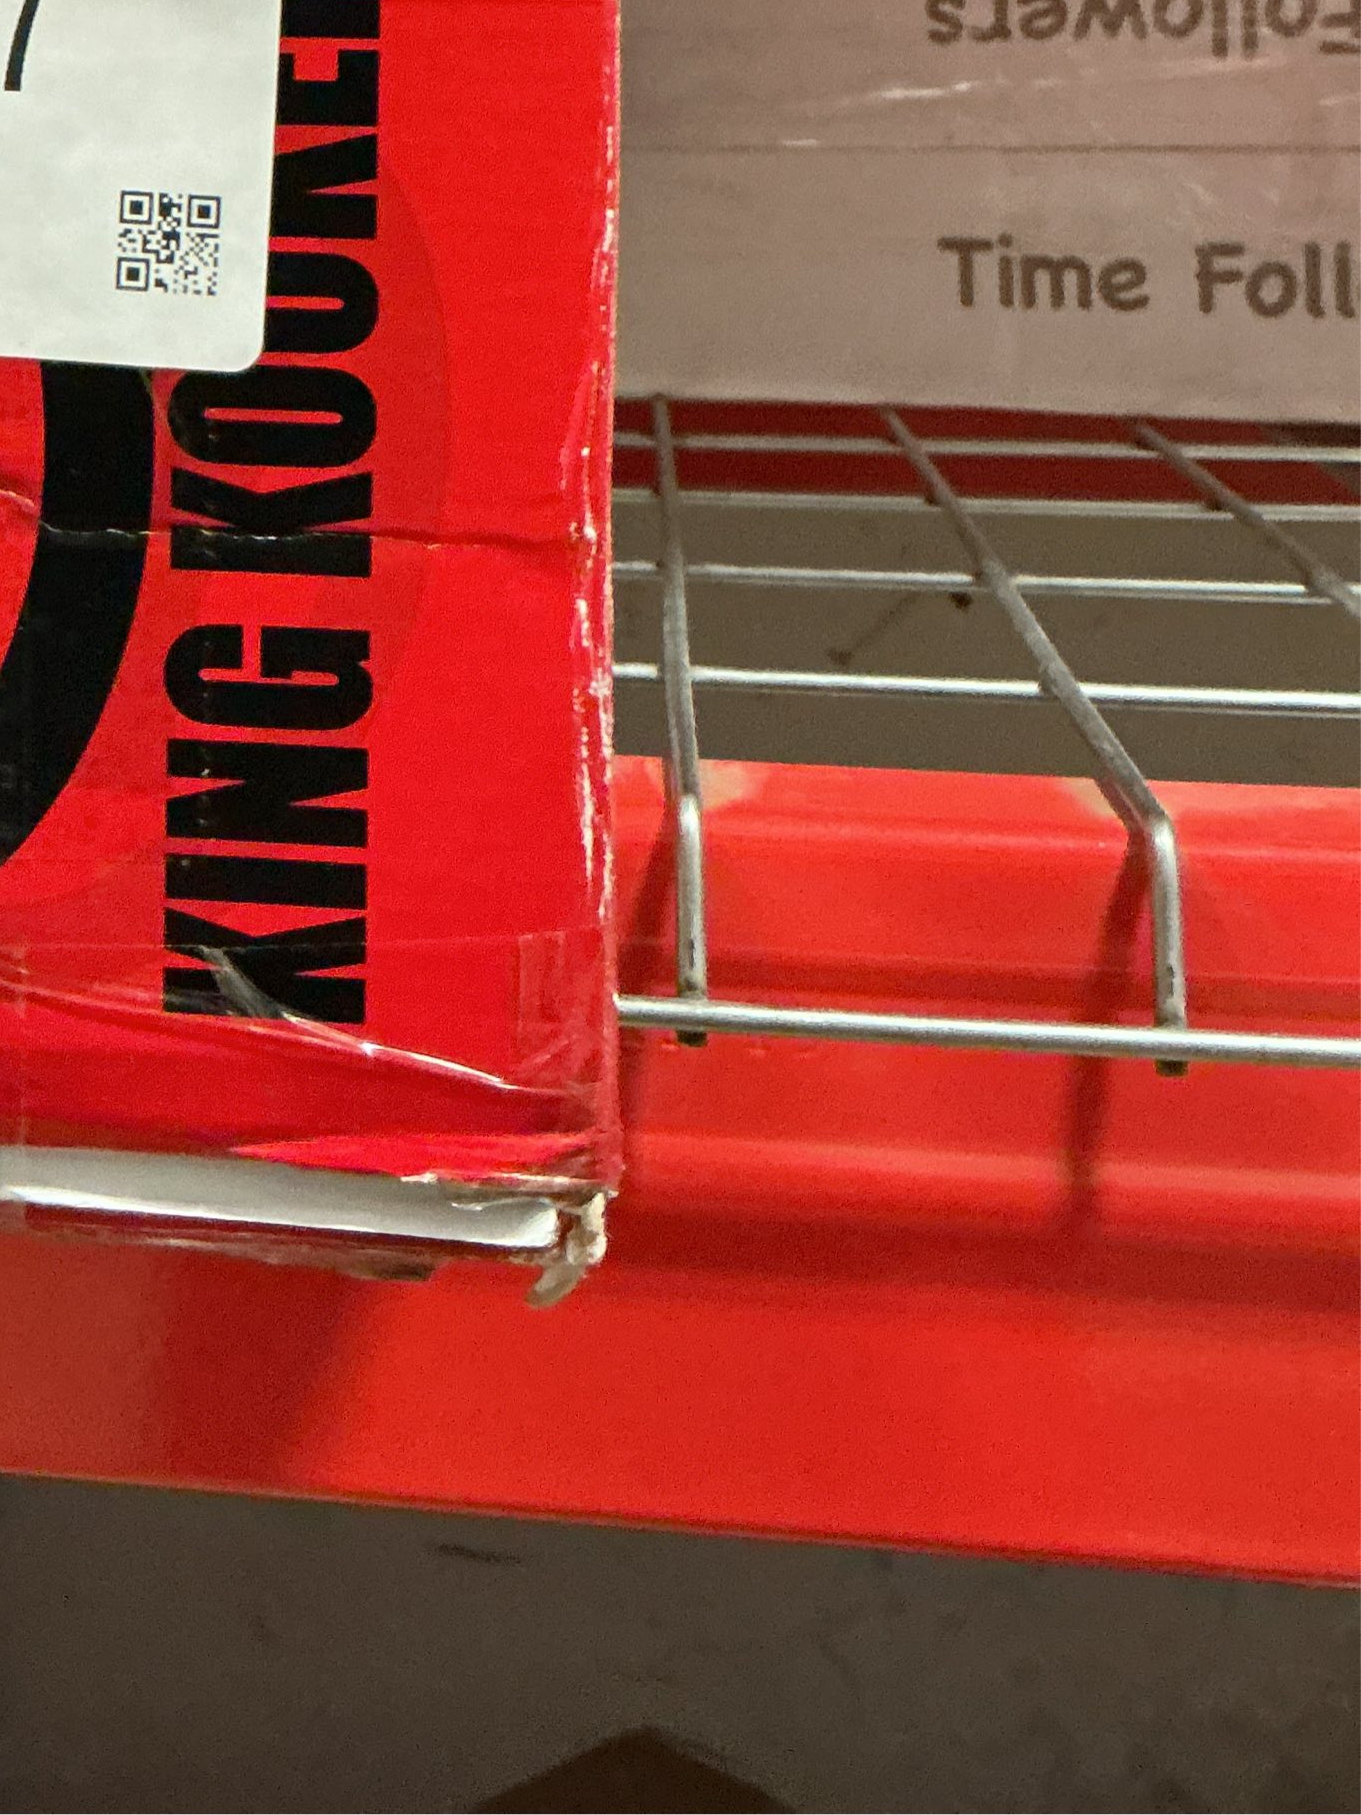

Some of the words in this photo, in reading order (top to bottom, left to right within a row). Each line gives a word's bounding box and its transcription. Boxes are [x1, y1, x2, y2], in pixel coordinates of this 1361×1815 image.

[937, 231, 1151, 313] Time
[1194, 238, 1361, 320] Foll
[163, 623, 373, 1025] KING
